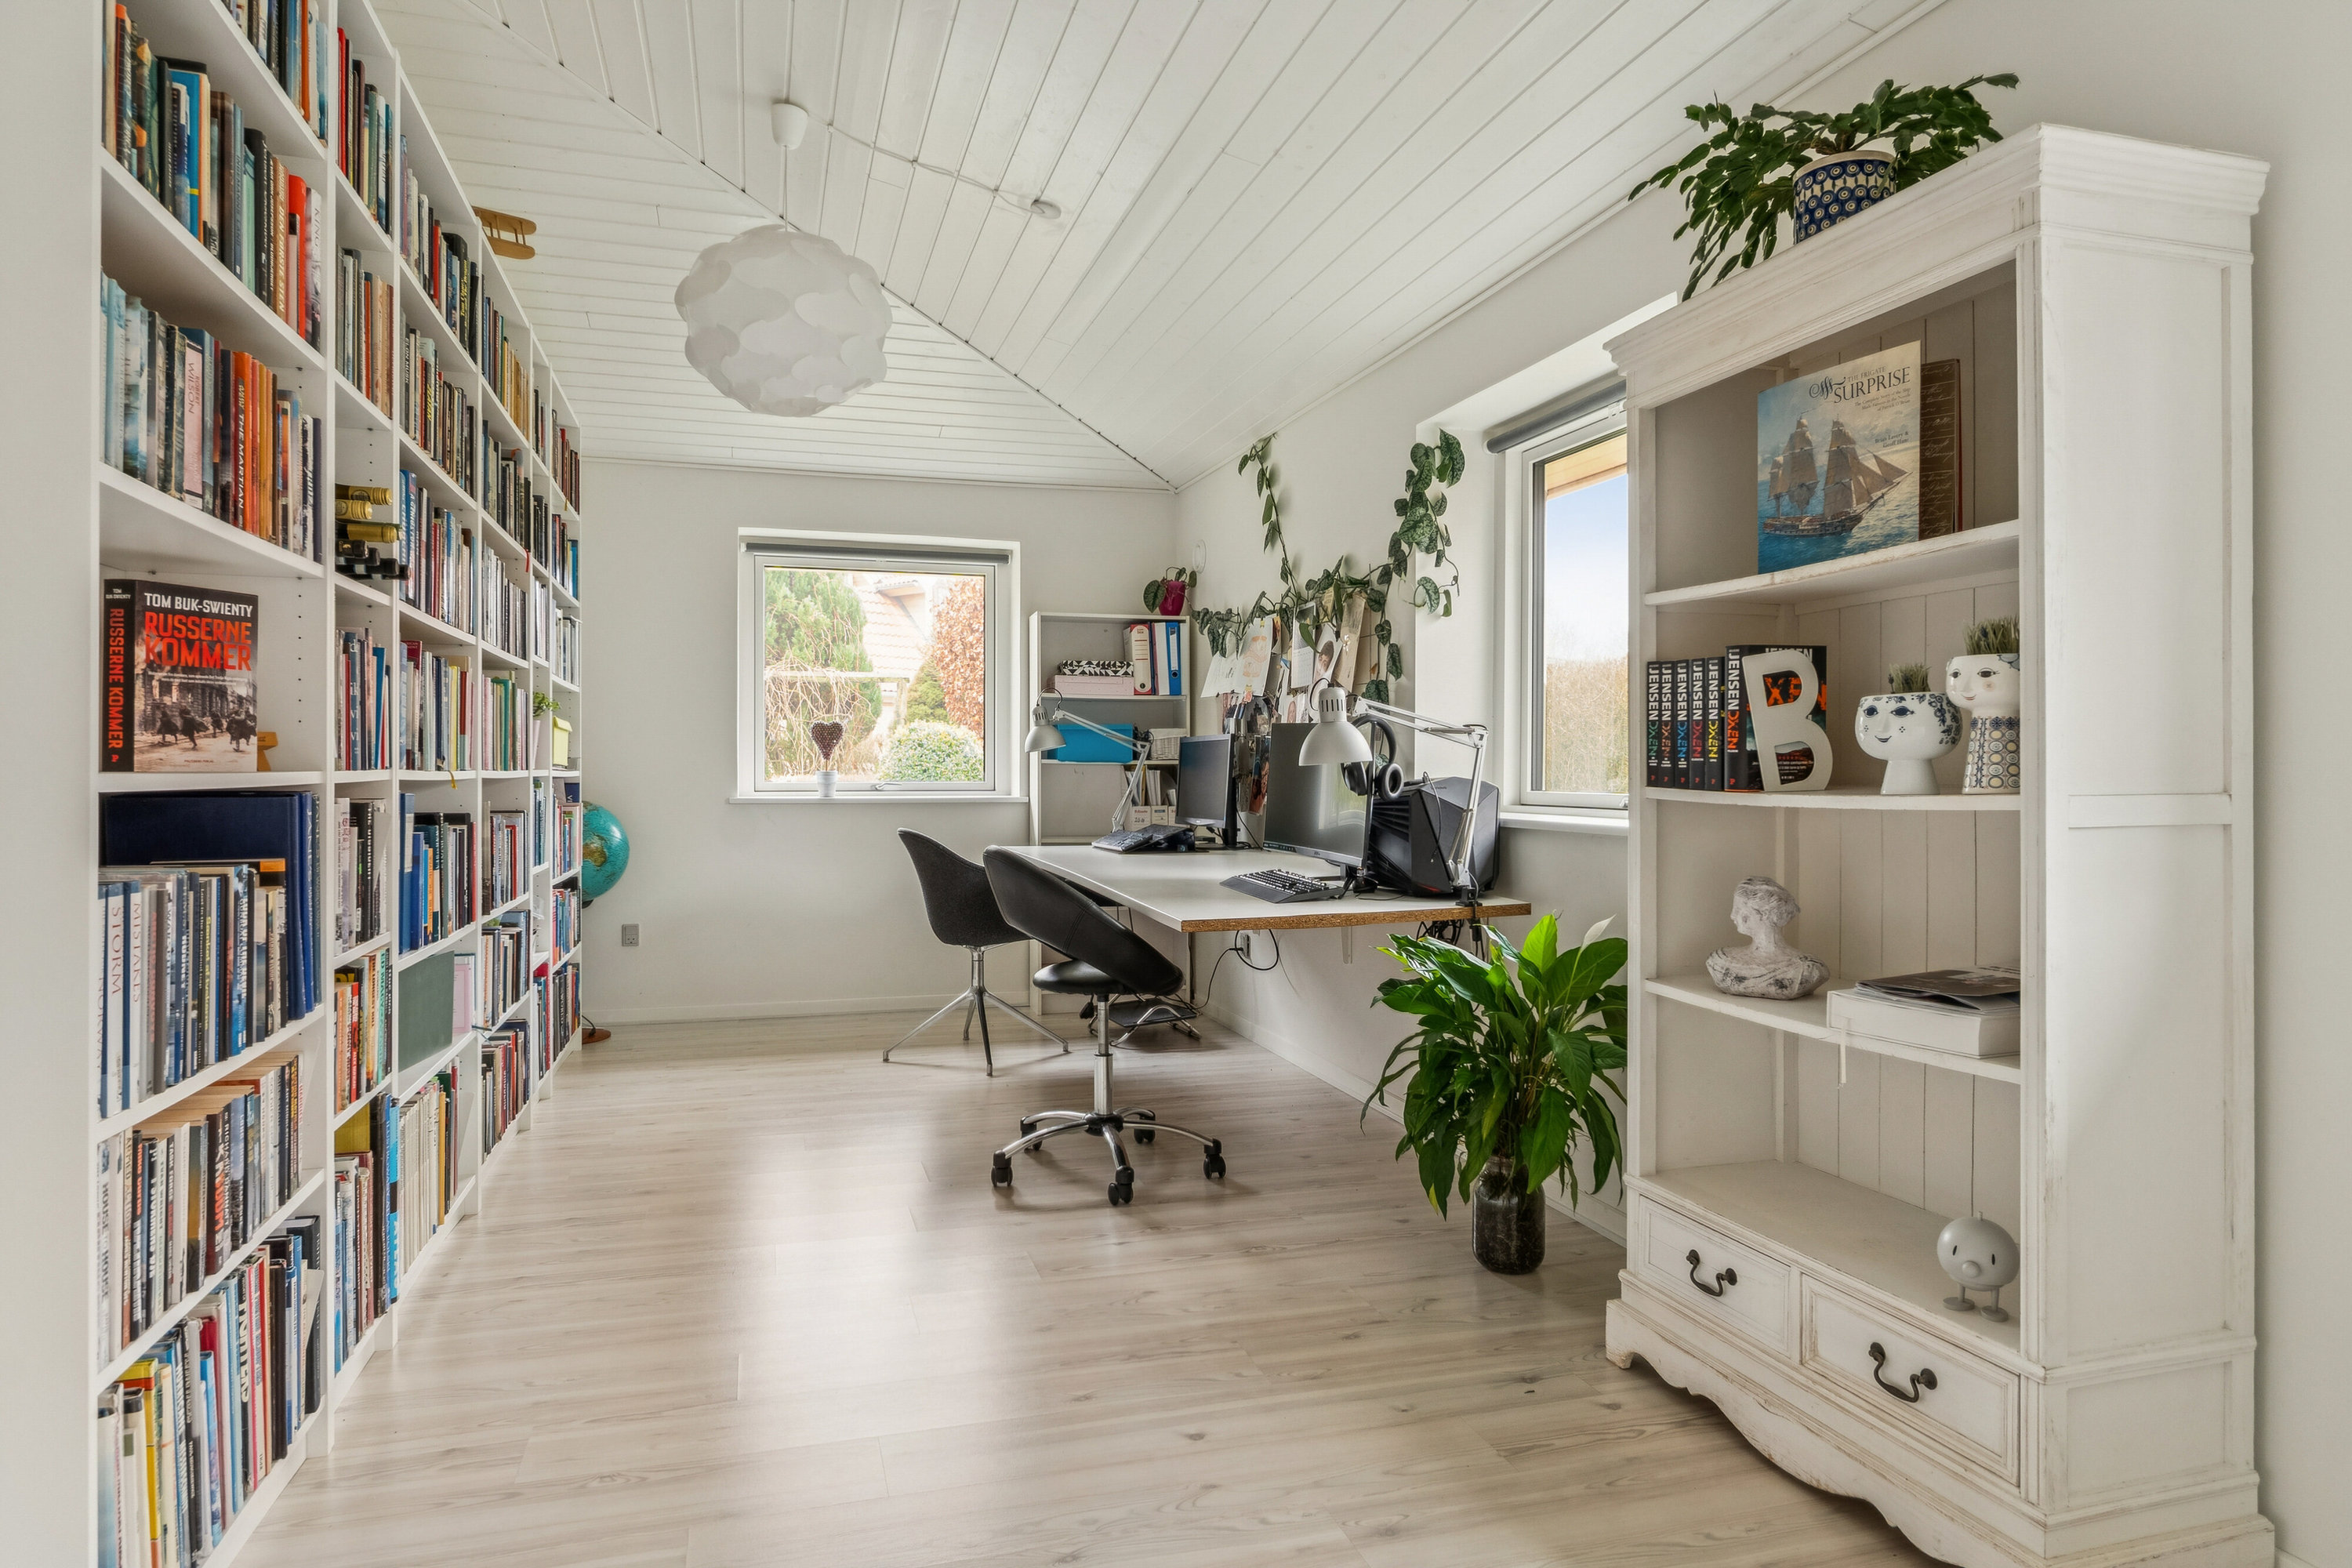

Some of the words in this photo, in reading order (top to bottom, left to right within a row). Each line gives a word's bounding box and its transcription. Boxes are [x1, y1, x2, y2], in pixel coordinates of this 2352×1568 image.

[1835, 366, 1911, 403] SURPRISE
[1860, 366, 1886, 379] FRIGATE
[144, 592, 172, 609] TOM
[174, 597, 253, 618] BUK-SWIENTY
[144, 612, 252, 644] RUSSERNE
[109, 608, 124, 683] RUSSERNE
[144, 633, 252, 671] KOMMER
[1649, 668, 1659, 720] JENSEN
[1661, 668, 1671, 720] JENSEN
[1678, 667, 1687, 720] JENSEN
[1693, 665, 1703, 720] JENSEN
[1708, 664, 1719, 720] JENSEN
[1727, 653, 1740, 710] JENSEN
[108, 687, 124, 749] KOMMER
[112, 906, 122, 996] STORM
[239, 1301, 249, 1403] FIGHTERS
